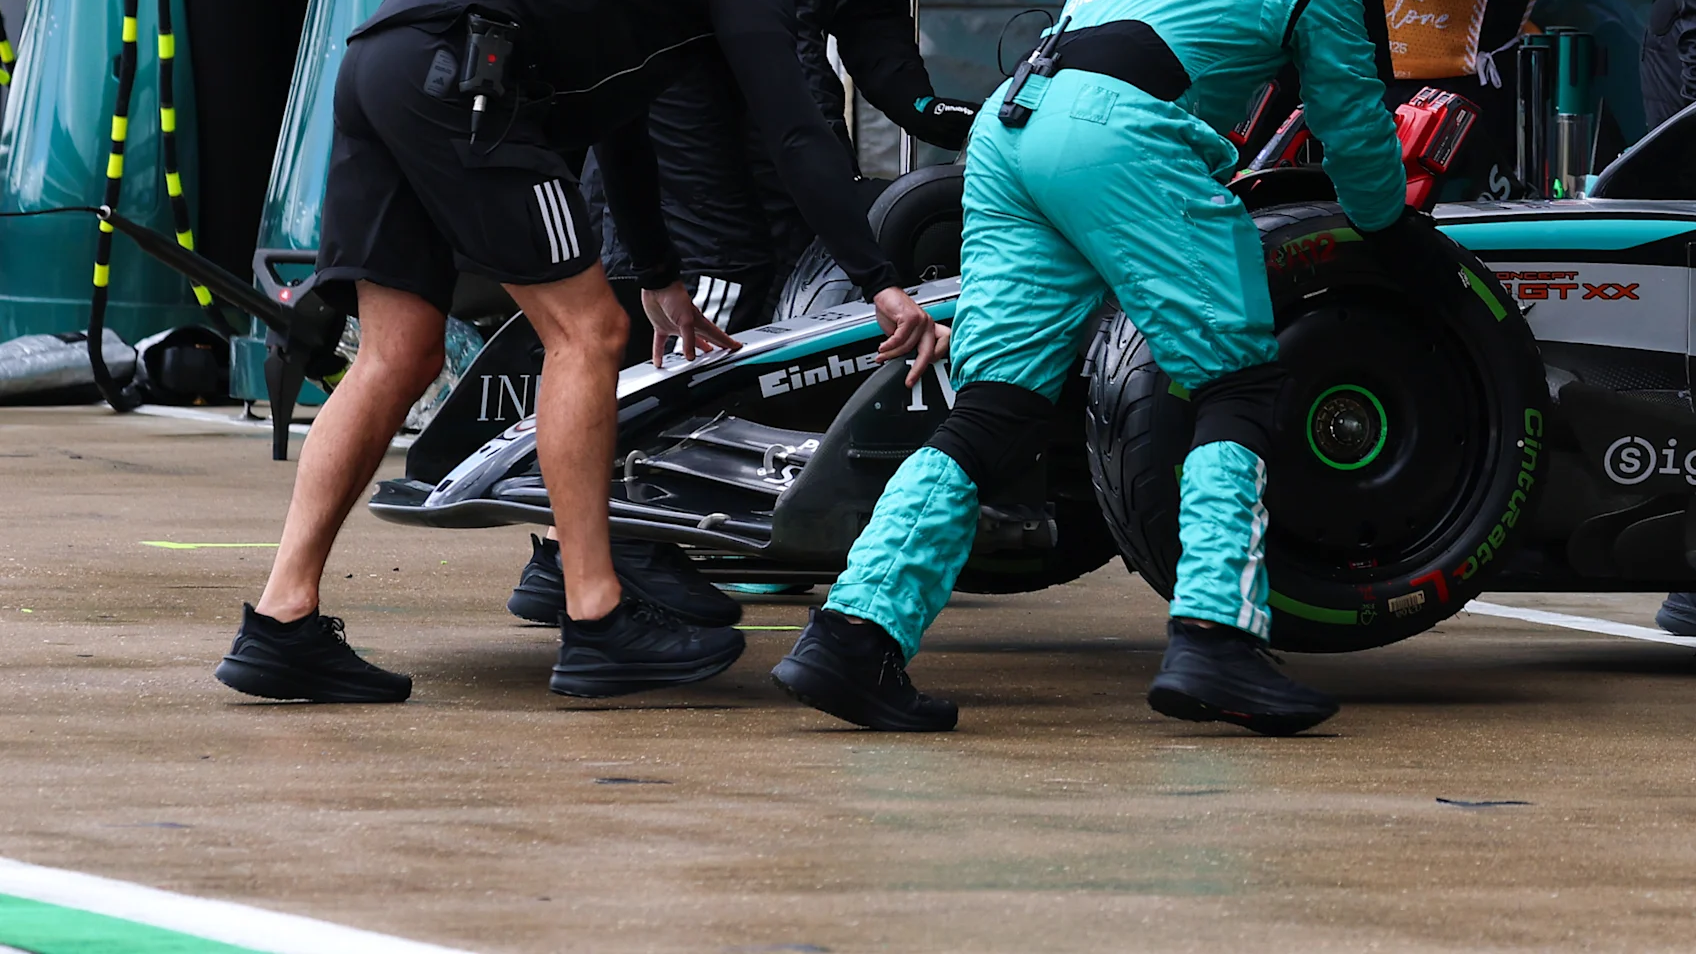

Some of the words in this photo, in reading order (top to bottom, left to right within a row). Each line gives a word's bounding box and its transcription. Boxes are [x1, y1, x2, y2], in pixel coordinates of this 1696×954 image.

[1495, 271, 1579, 281] ONCEPT
[1517, 283, 1579, 300] GT
[1582, 283, 1640, 300] XX
[758, 348, 890, 399] Einhe
